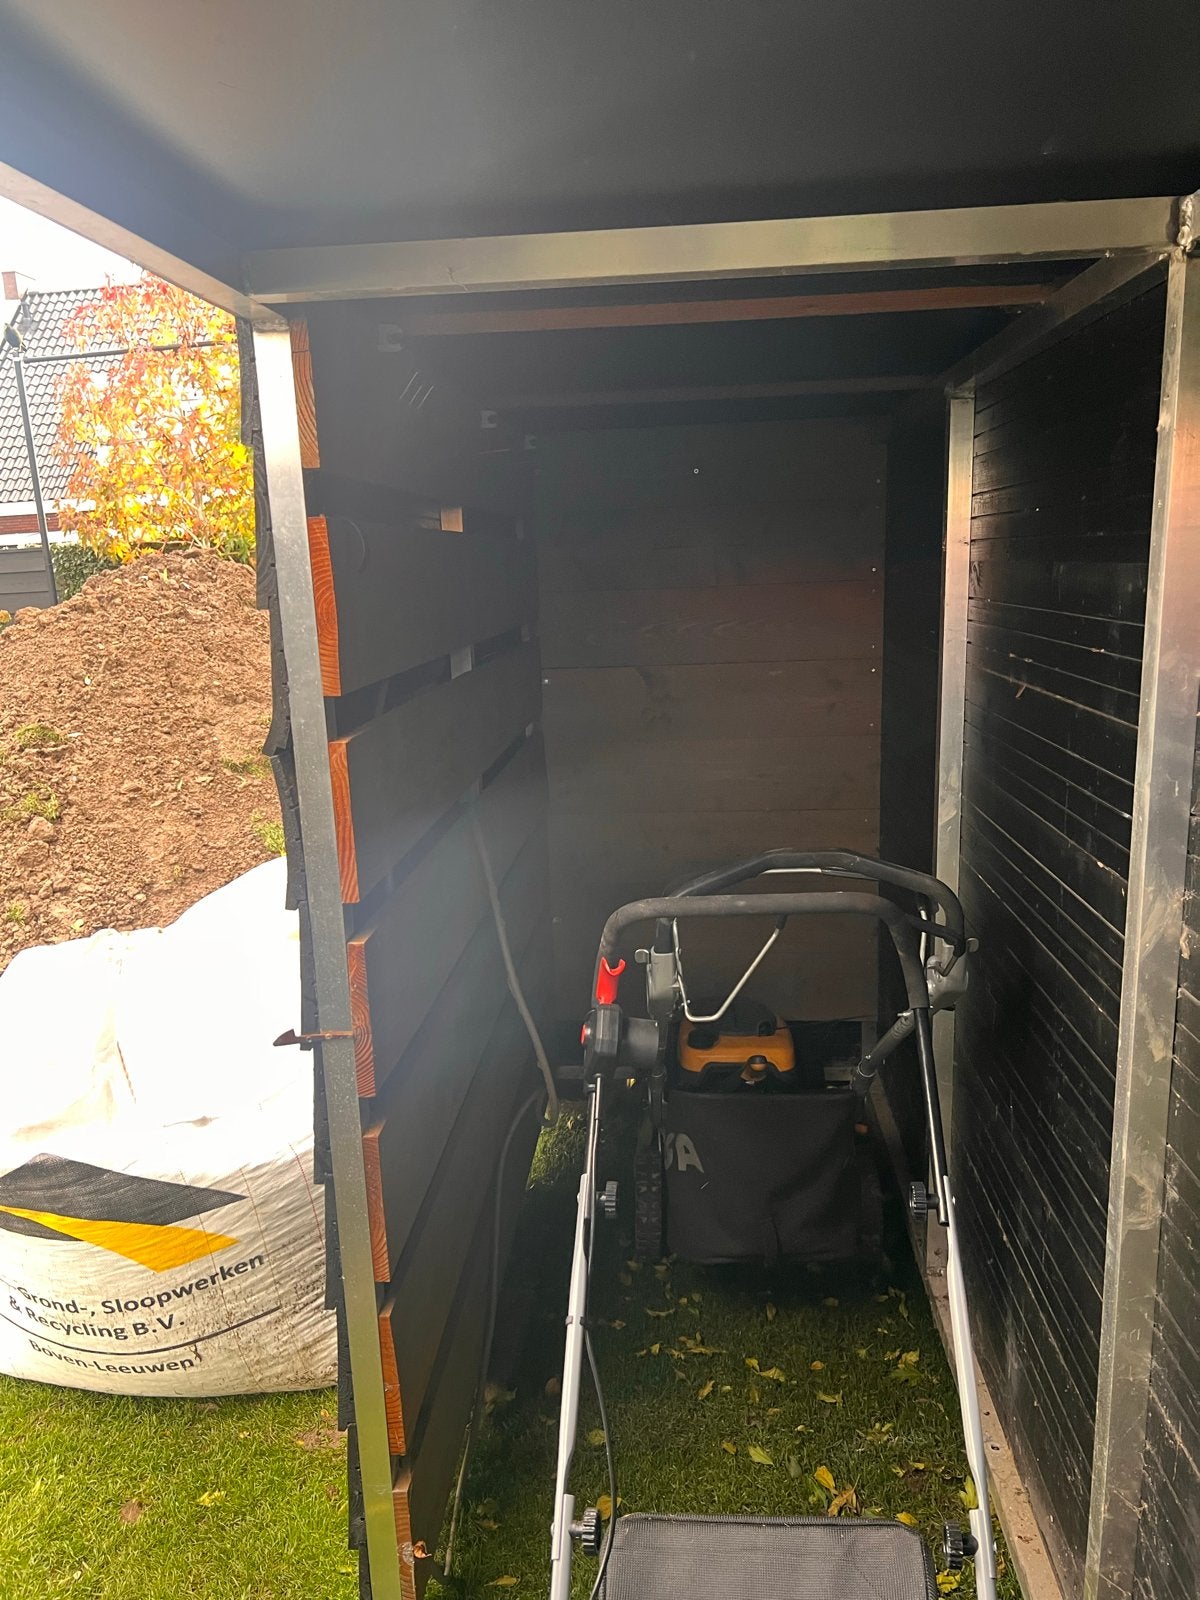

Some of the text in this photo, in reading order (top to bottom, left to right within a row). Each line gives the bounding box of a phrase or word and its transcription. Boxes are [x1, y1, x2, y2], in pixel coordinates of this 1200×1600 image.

[101, 1253, 265, 1315] Sloopwerken
[9, 1295, 186, 1340] & Recycling B.V.
[28, 1339, 195, 1374] Boven-Leeuwen
